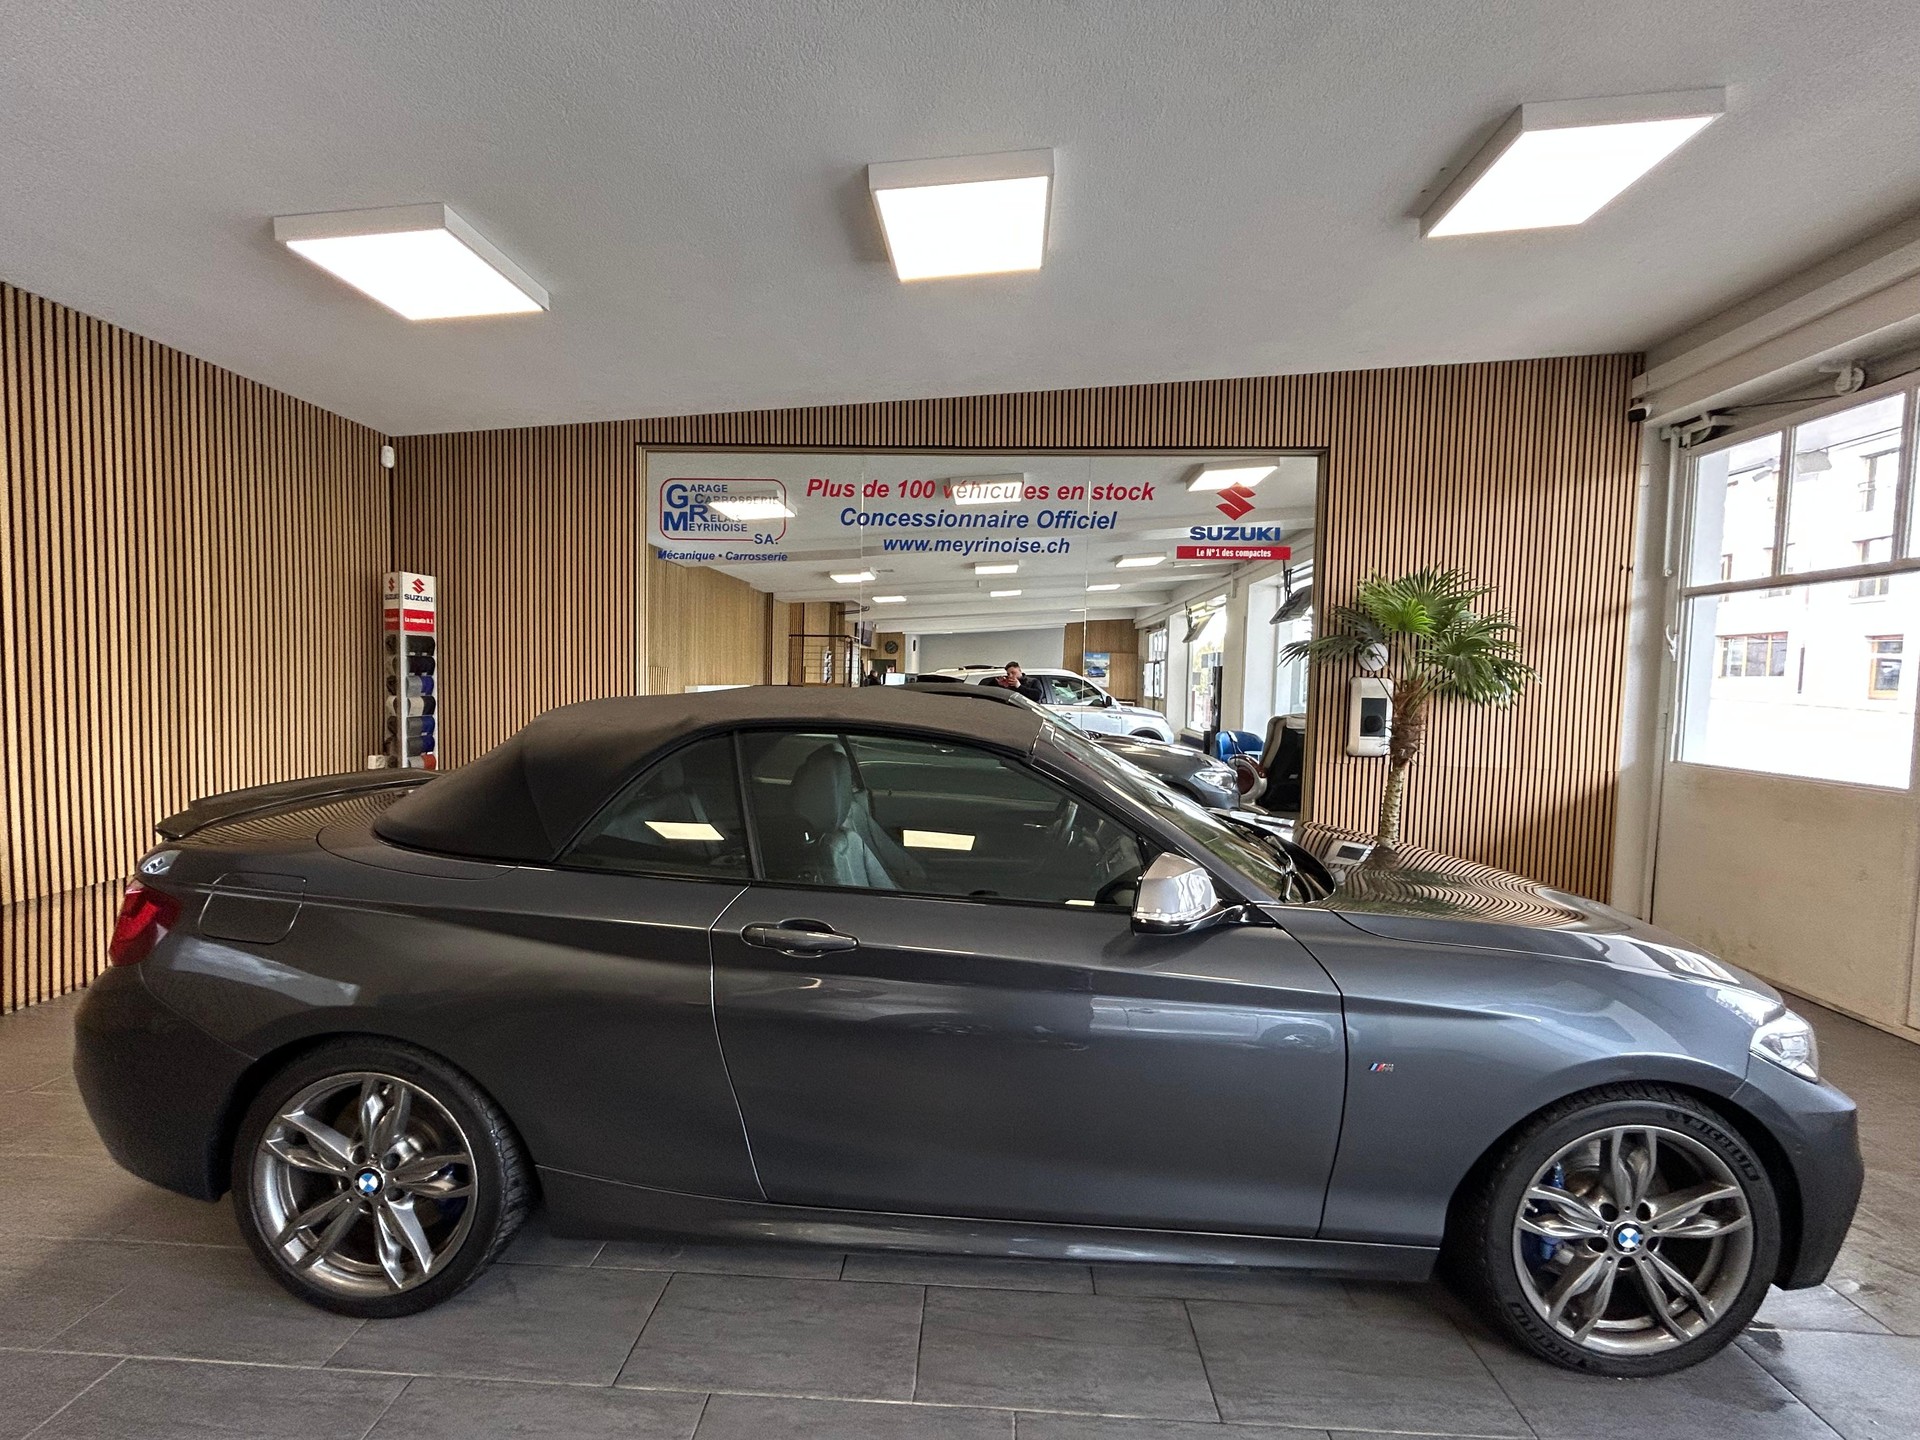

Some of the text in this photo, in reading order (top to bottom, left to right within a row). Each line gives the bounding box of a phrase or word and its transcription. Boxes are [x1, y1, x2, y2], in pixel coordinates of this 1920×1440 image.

[806, 478, 1156, 501] Plus de 100 véhicules en stock
[663, 511, 748, 532] MEYRINOISE
[840, 507, 1118, 530] Concessionnaire Officiel
[1189, 526, 1281, 542] SUZUKI
[883, 537, 1070, 556] www.meyrinoise.ch
[1196, 548, 1205, 557] Le
[1221, 548, 1234, 557] des
[1235, 549, 1272, 559] compactes
[657, 549, 788, 562] Mécanique Carrosserie
[404, 594, 433, 602] SUZUKI
